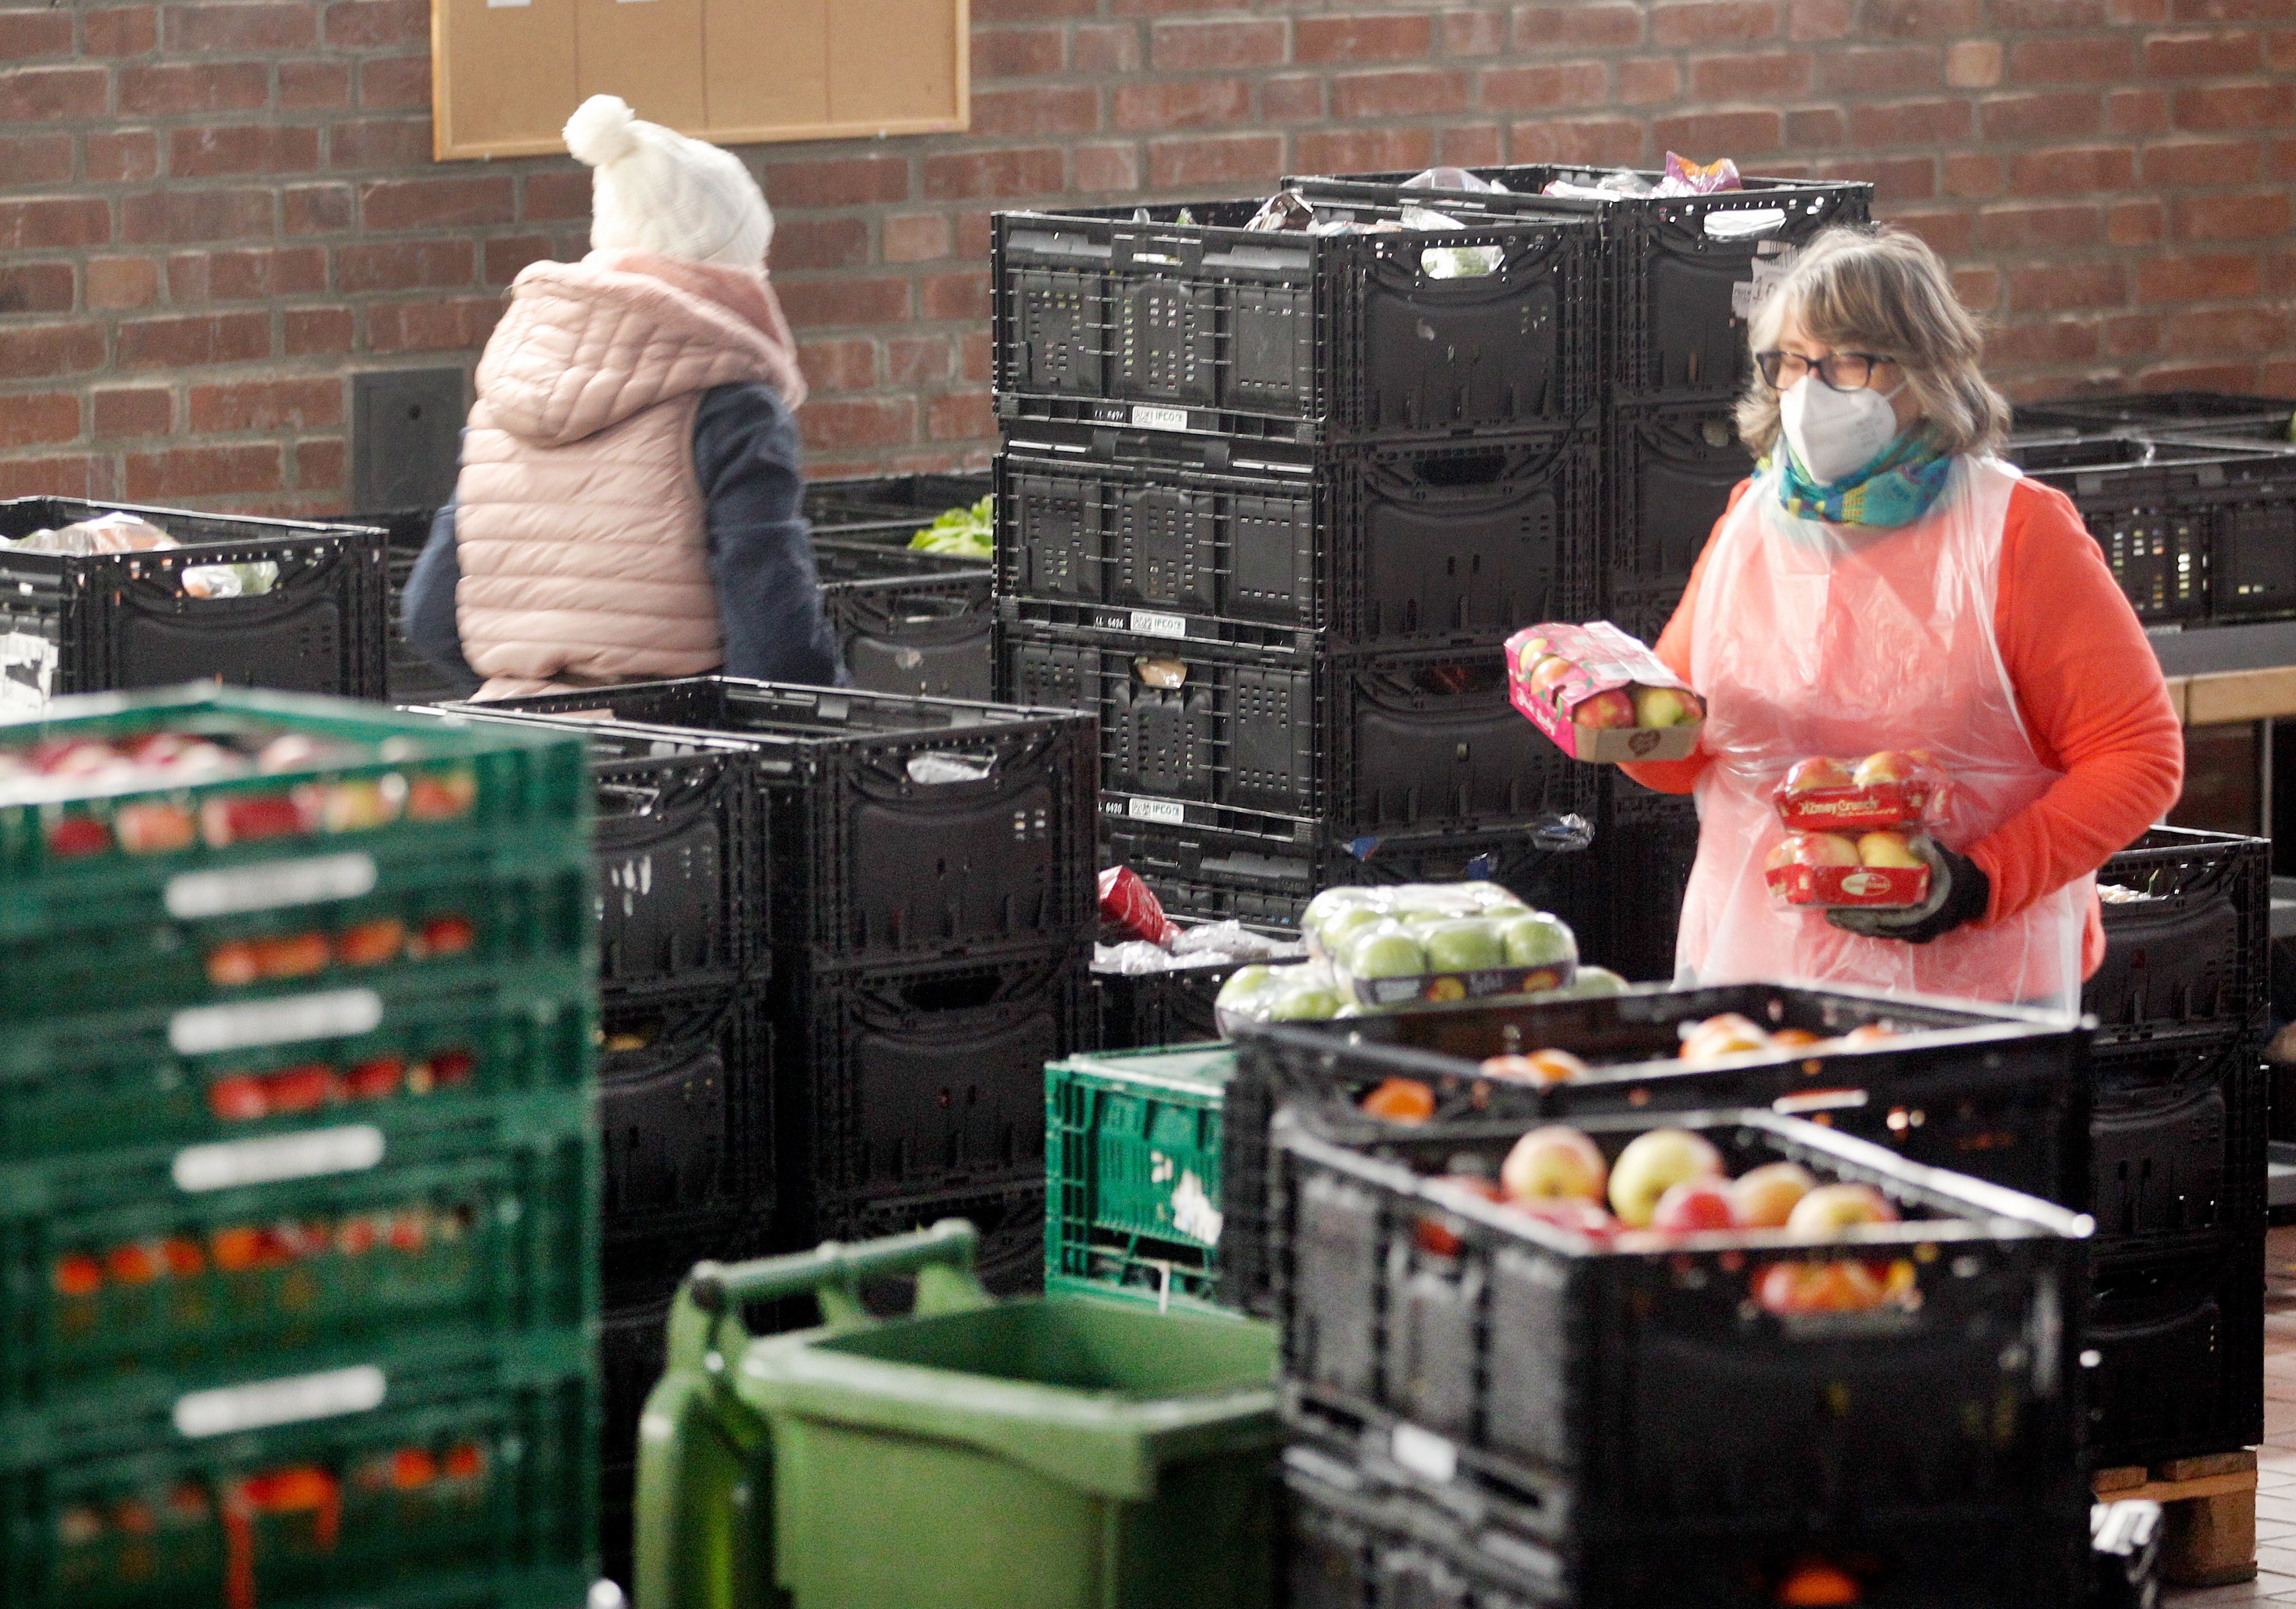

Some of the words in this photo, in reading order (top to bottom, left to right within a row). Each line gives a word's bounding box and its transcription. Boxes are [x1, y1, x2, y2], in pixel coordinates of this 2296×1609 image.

[1155, 411, 1174, 421] IFCO
[1154, 618, 1173, 628] IFCO
[1105, 802, 1122, 814] 6420
[1152, 804, 1171, 814] IFCO
